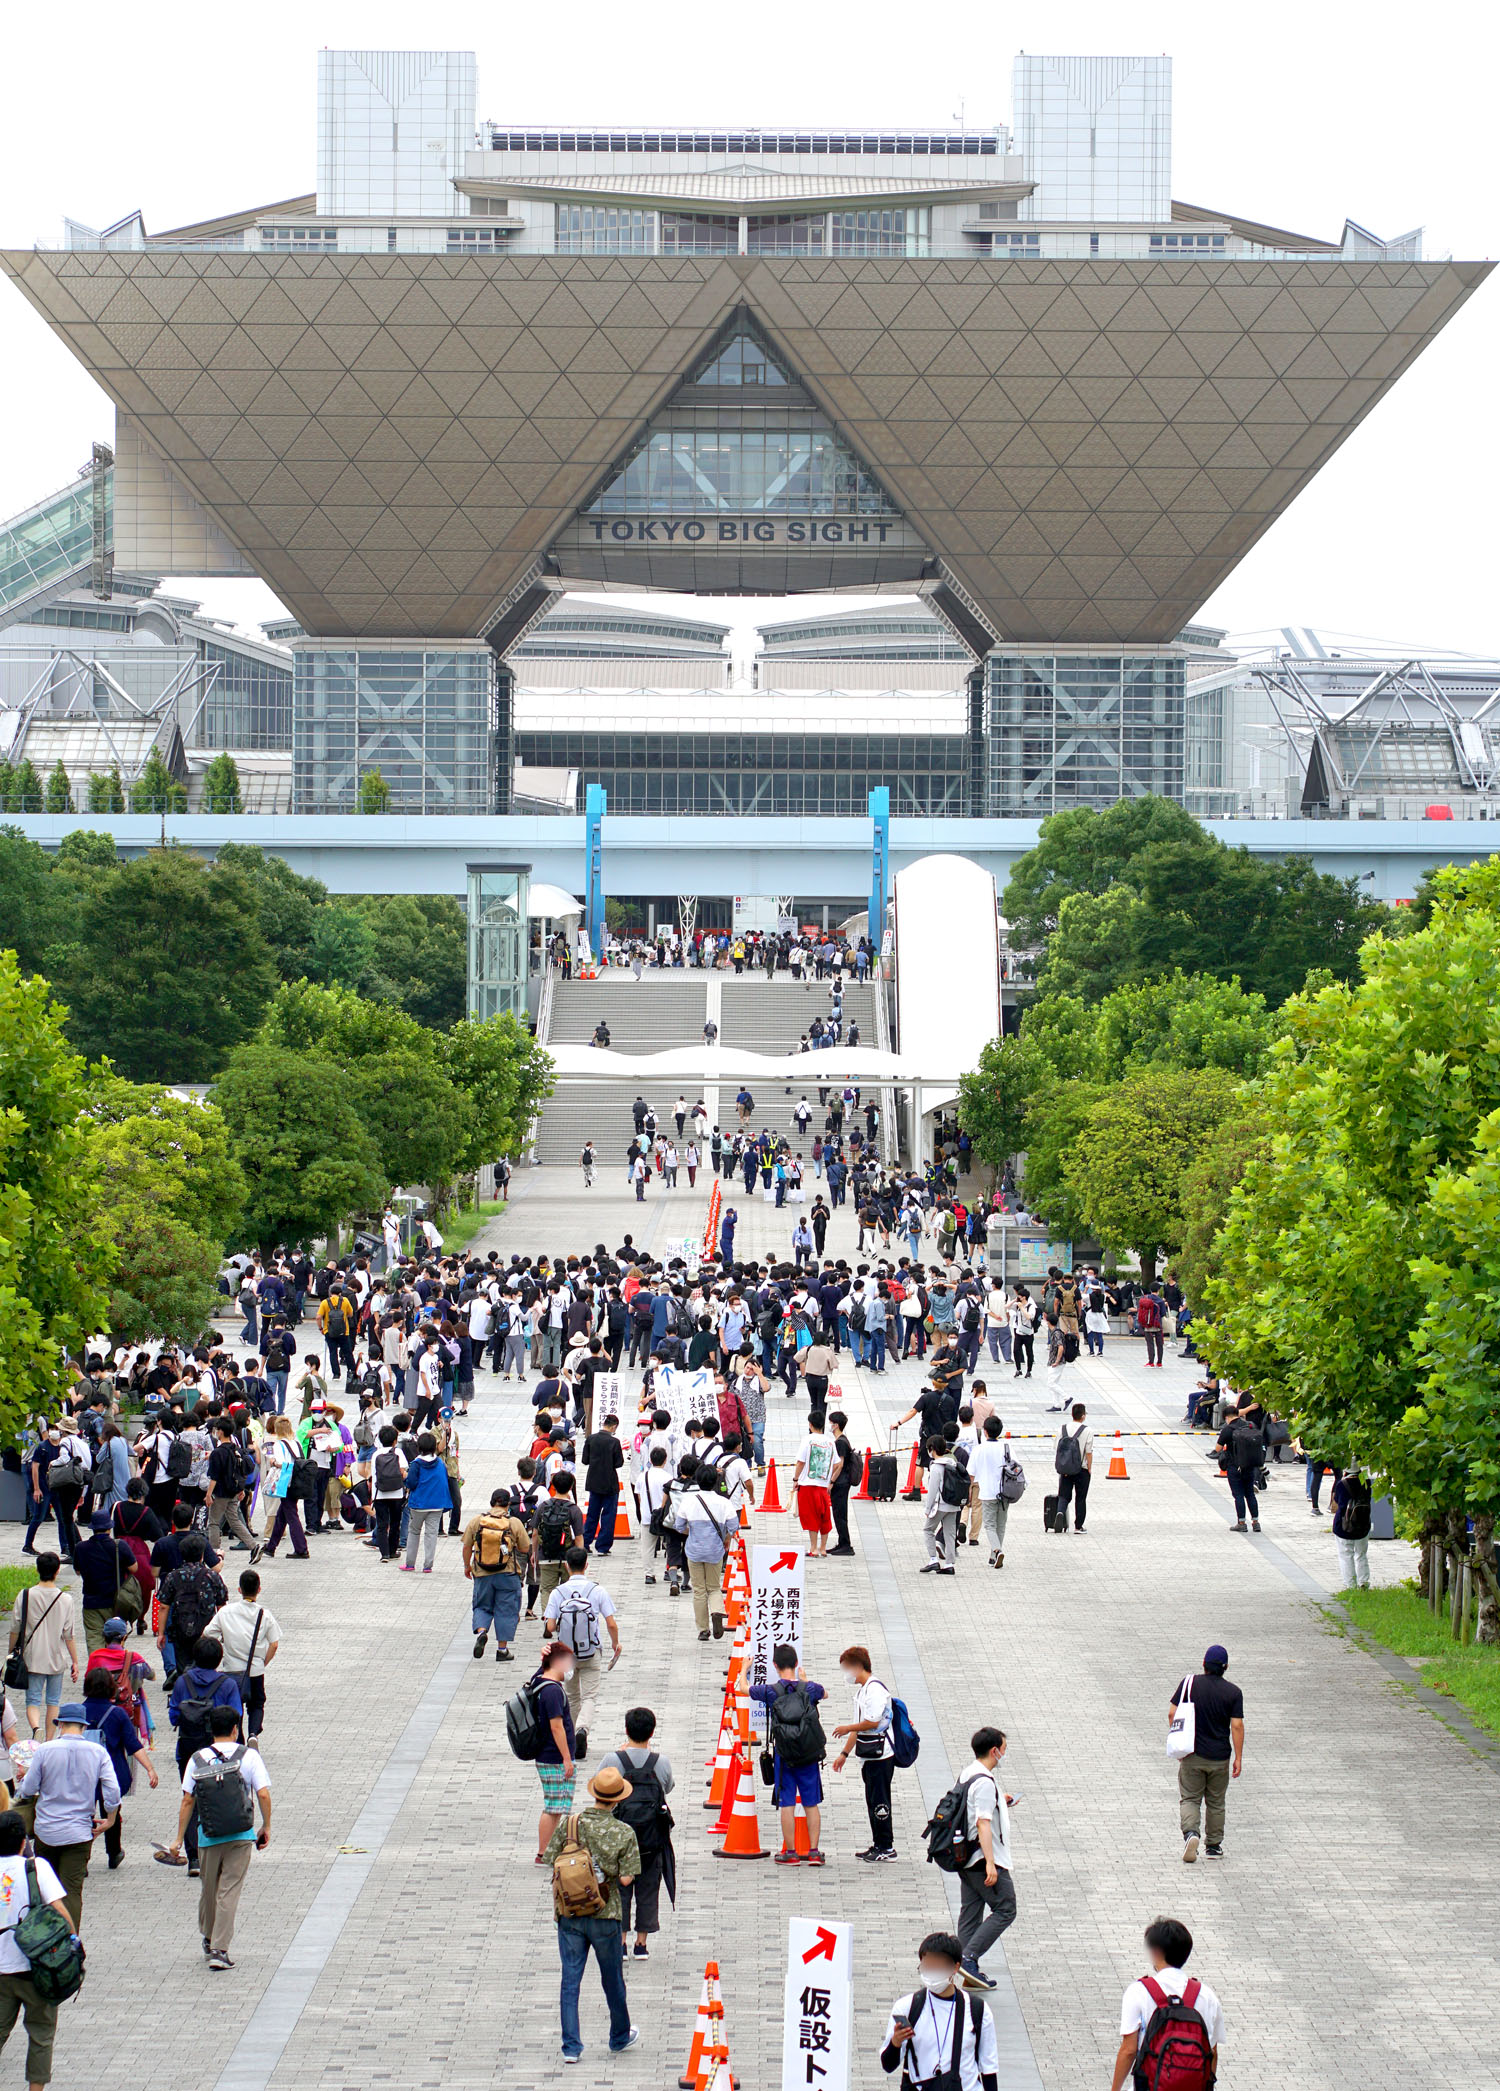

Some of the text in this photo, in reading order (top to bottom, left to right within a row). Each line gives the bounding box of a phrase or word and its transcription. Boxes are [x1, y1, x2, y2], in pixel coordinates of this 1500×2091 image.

[588, 520, 893, 542] TOKYO BIG SIGHT
[754, 1588, 768, 1685] リストバンド交換所
[786, 1588, 800, 1642] 西南ホール
[799, 1986, 831, 2091] 仮設ト
